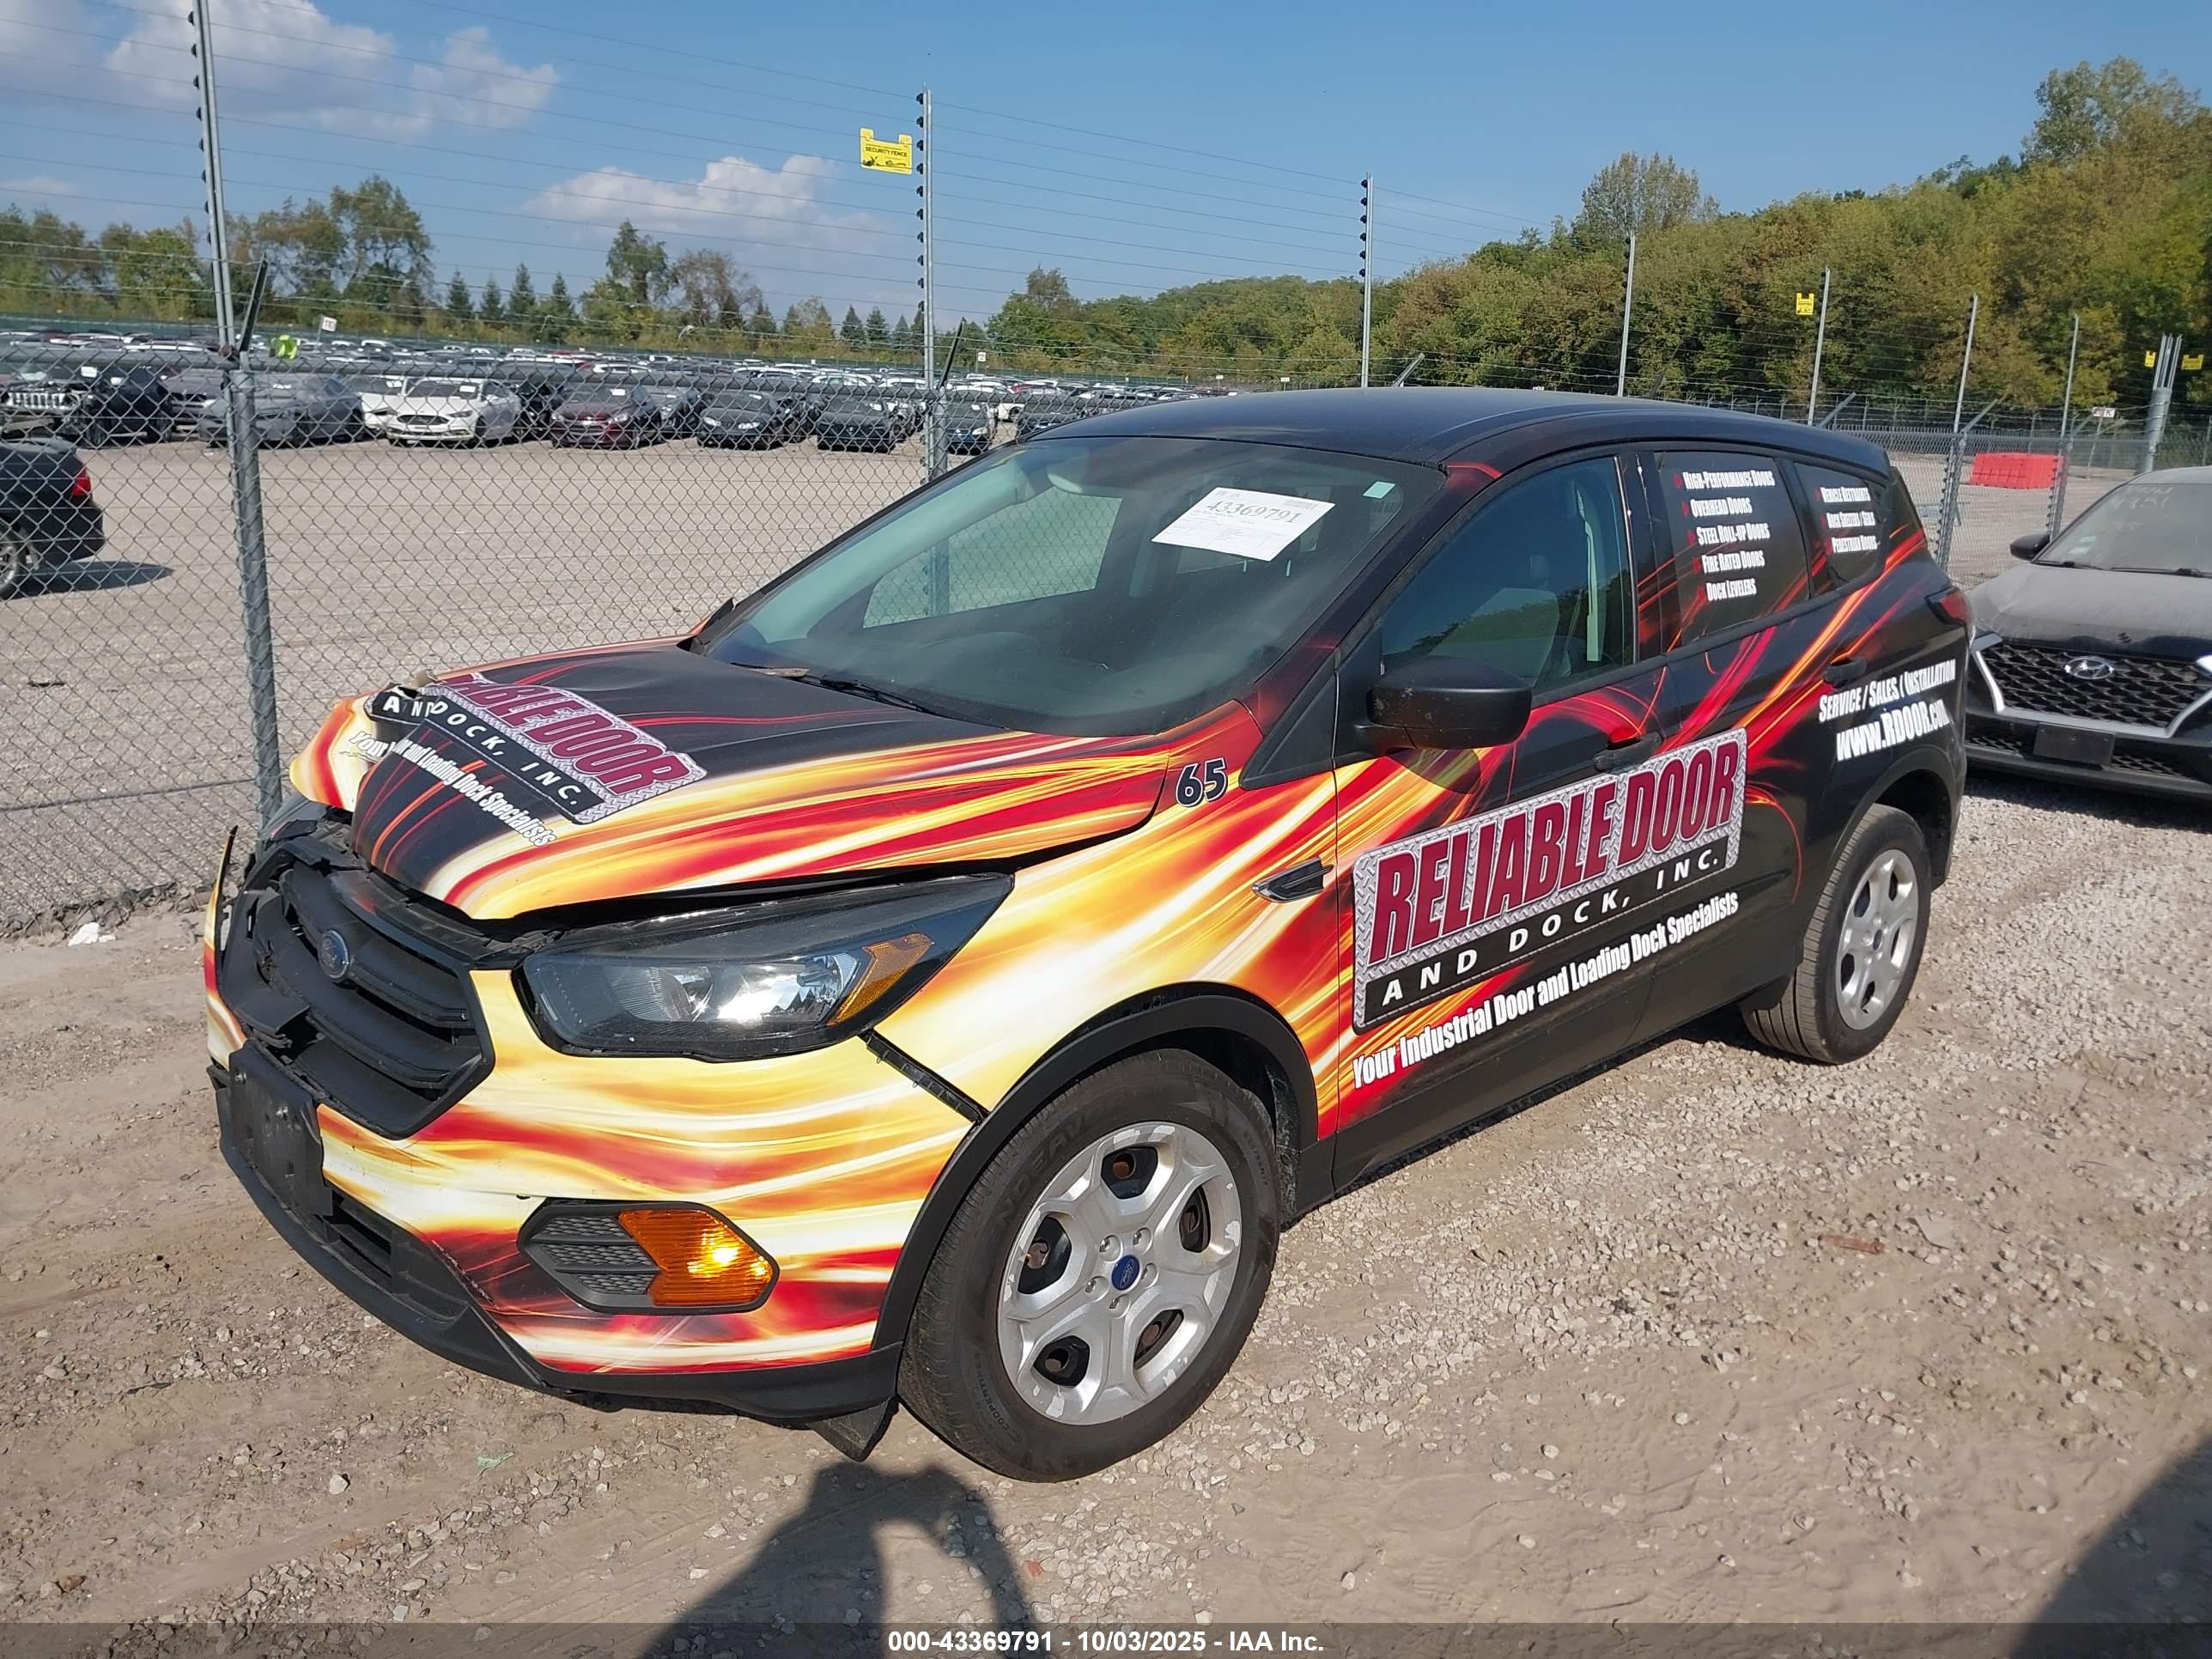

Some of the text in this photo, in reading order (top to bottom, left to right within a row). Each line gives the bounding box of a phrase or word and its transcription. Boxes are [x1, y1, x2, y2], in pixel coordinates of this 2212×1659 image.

[1206, 501, 1302, 523] 43369791
[349, 731, 389, 757] Your
[416, 749, 462, 786] Loading
[451, 769, 494, 802] Dock
[478, 792, 557, 847] Specialists
[520, 762, 582, 805] INC.
[521, 713, 690, 796] DOOR
[1176, 757, 1228, 808] 65
[1367, 738, 1740, 965] RELIABLE DOOR
[1382, 848, 1718, 1007] AND DOCK, INC.
[1352, 891, 1739, 1089] Your Industrial Door and Loading Dock Specialists
